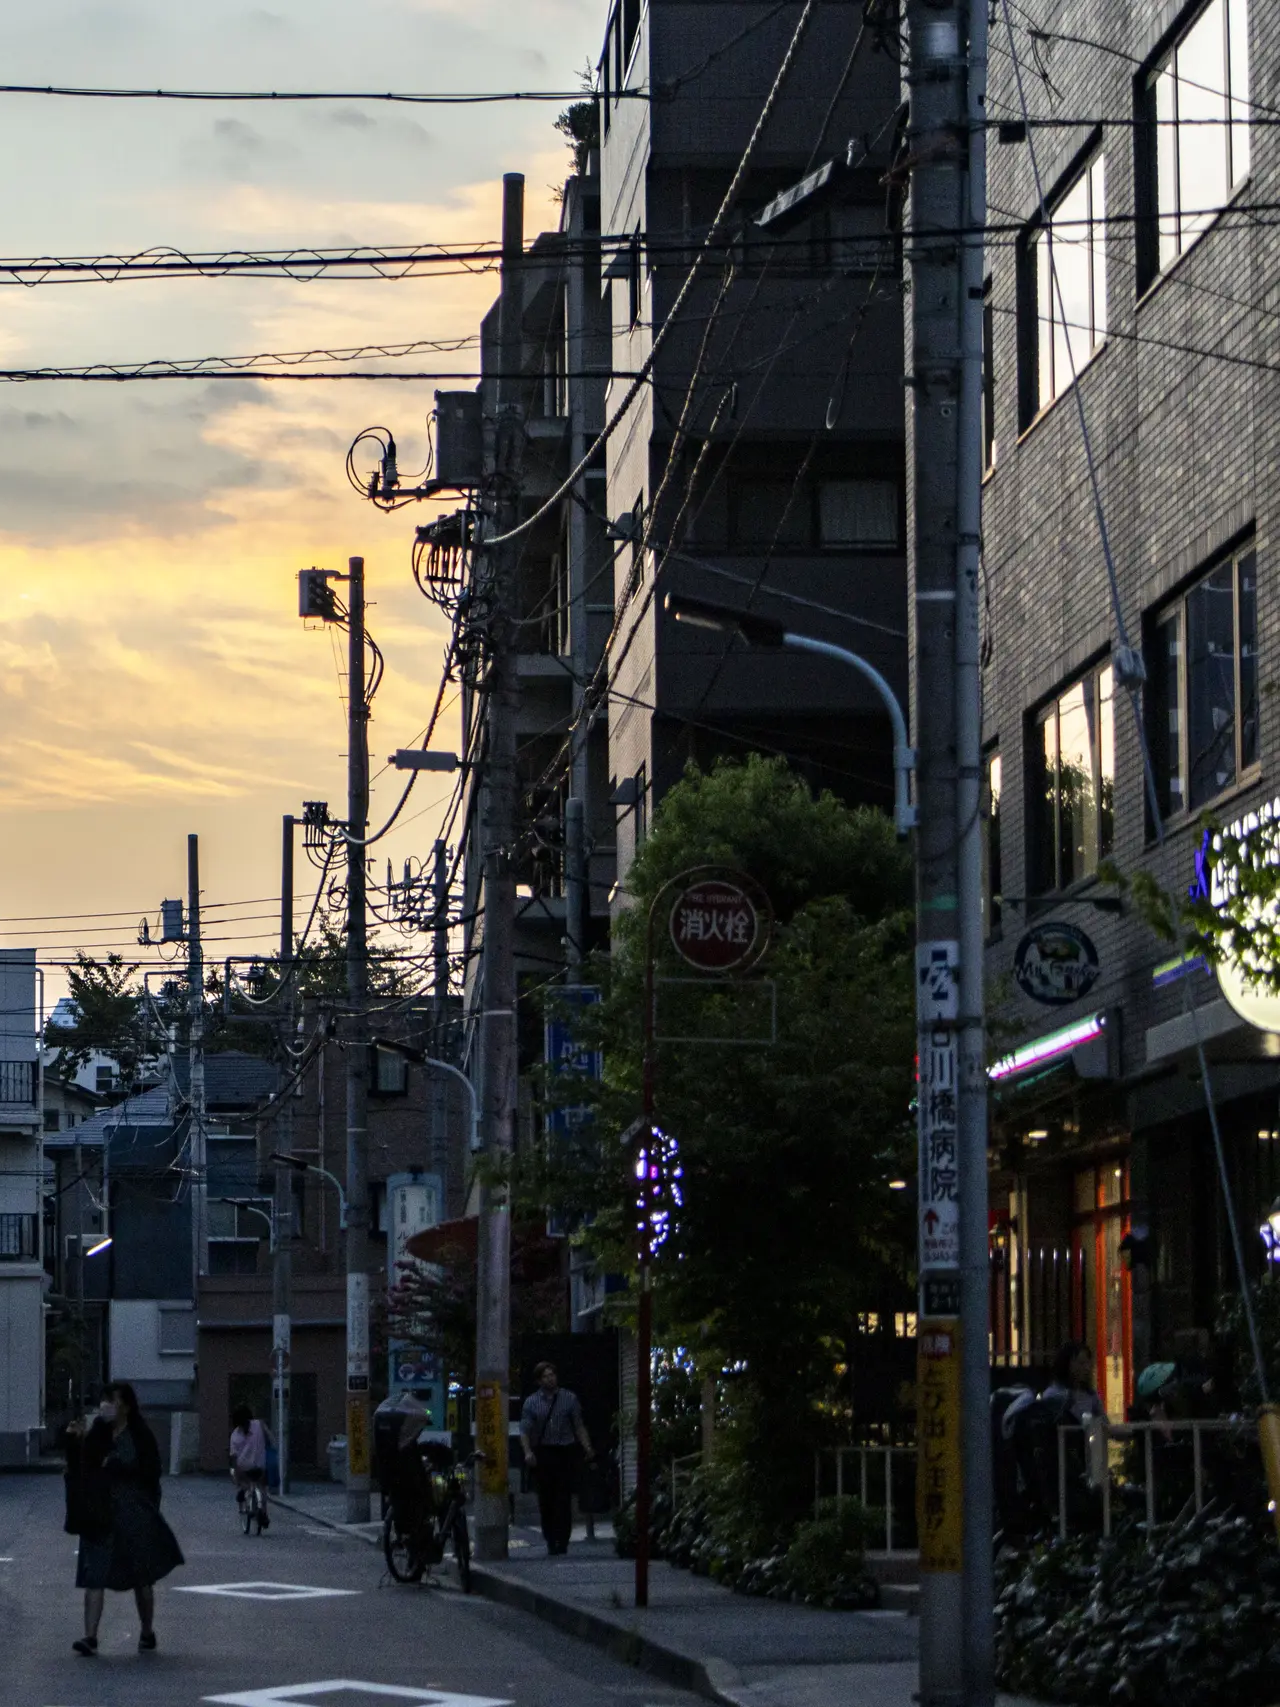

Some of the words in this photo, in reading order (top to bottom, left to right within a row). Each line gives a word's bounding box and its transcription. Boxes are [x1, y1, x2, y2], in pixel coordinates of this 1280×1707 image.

[680, 908, 749, 943] 消火栓
[930, 1011, 958, 1202] 古川橋病院
